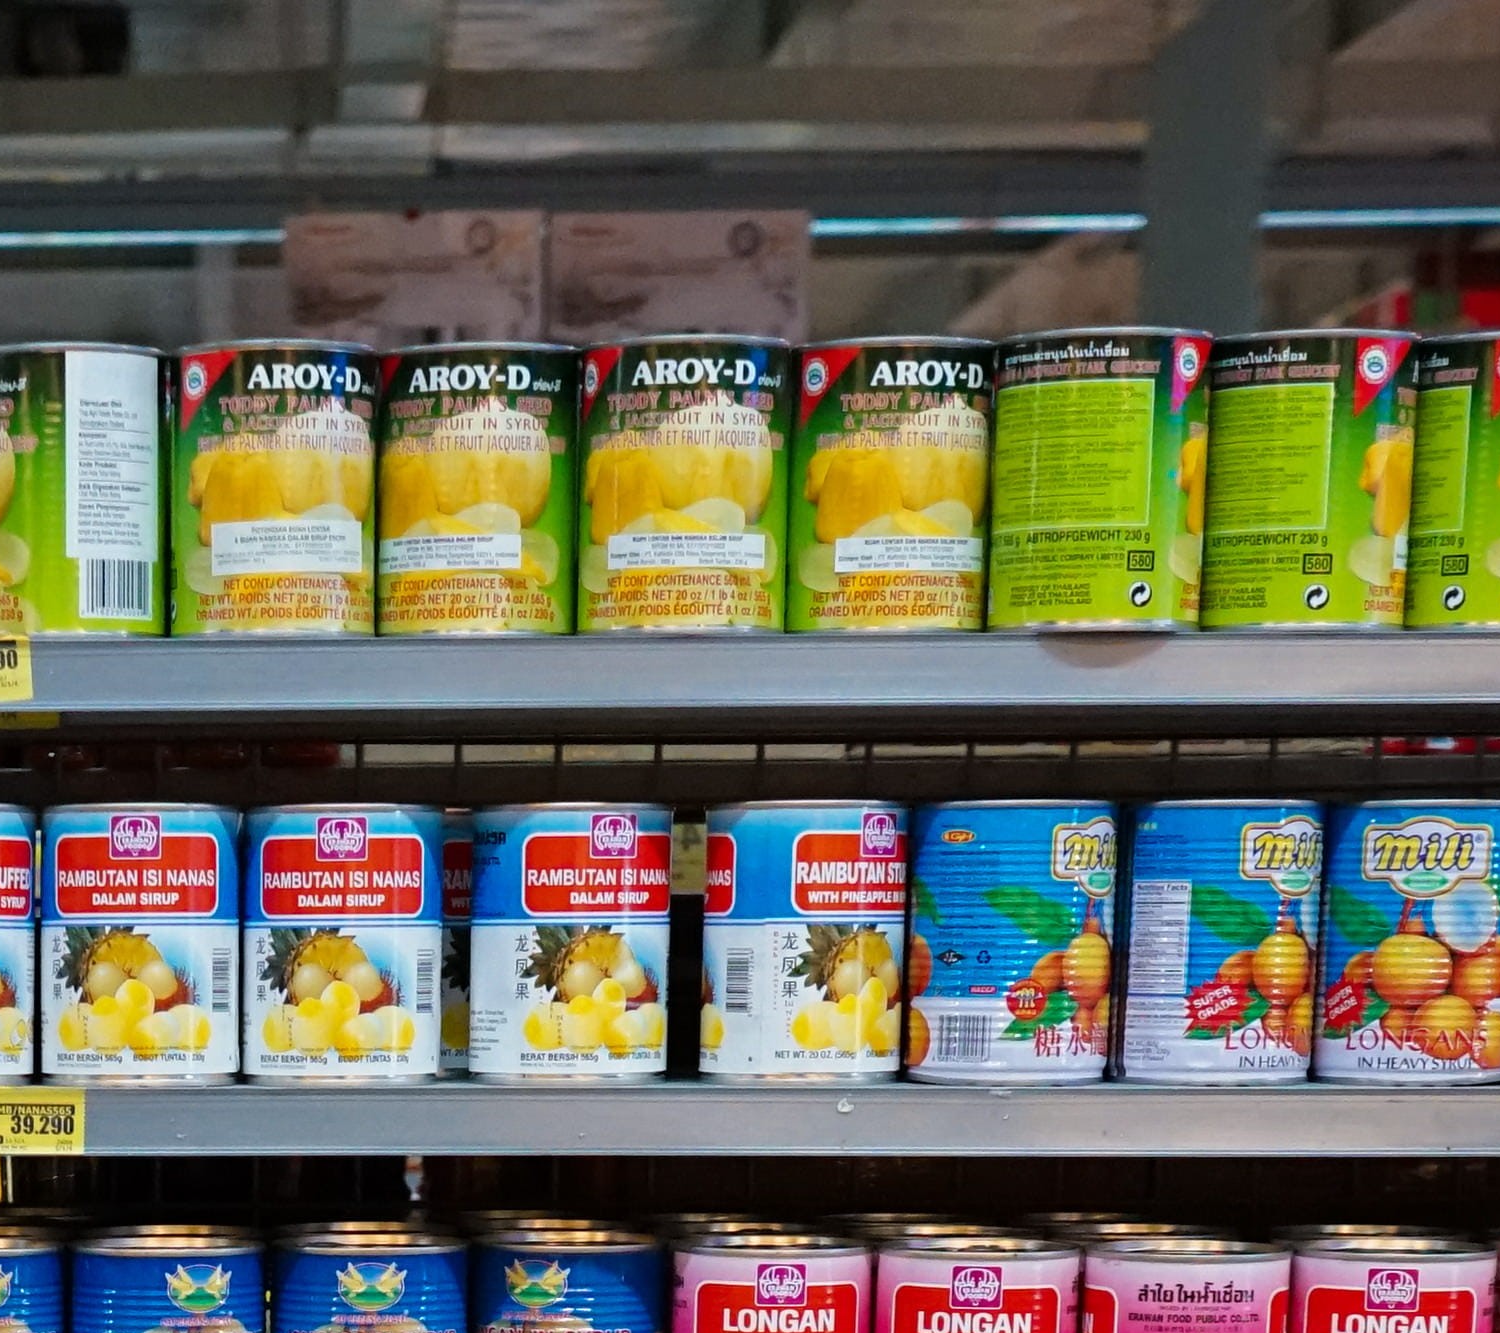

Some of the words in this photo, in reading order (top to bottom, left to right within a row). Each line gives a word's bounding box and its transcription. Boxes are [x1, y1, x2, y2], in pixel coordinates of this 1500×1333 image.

[248, 361, 361, 391] AROY-D
[59, 869, 140, 888] RAMBUTAN
[143, 869, 162, 887] ISI
[166, 869, 214, 887] NANAS
[93, 892, 136, 906] DALAM
[140, 892, 178, 906] SIRUP
[1346, 1029, 1487, 1052] LONGANS
[11, 1115, 75, 1135] 39.290
[722, 1307, 835, 1333] LONGAN
